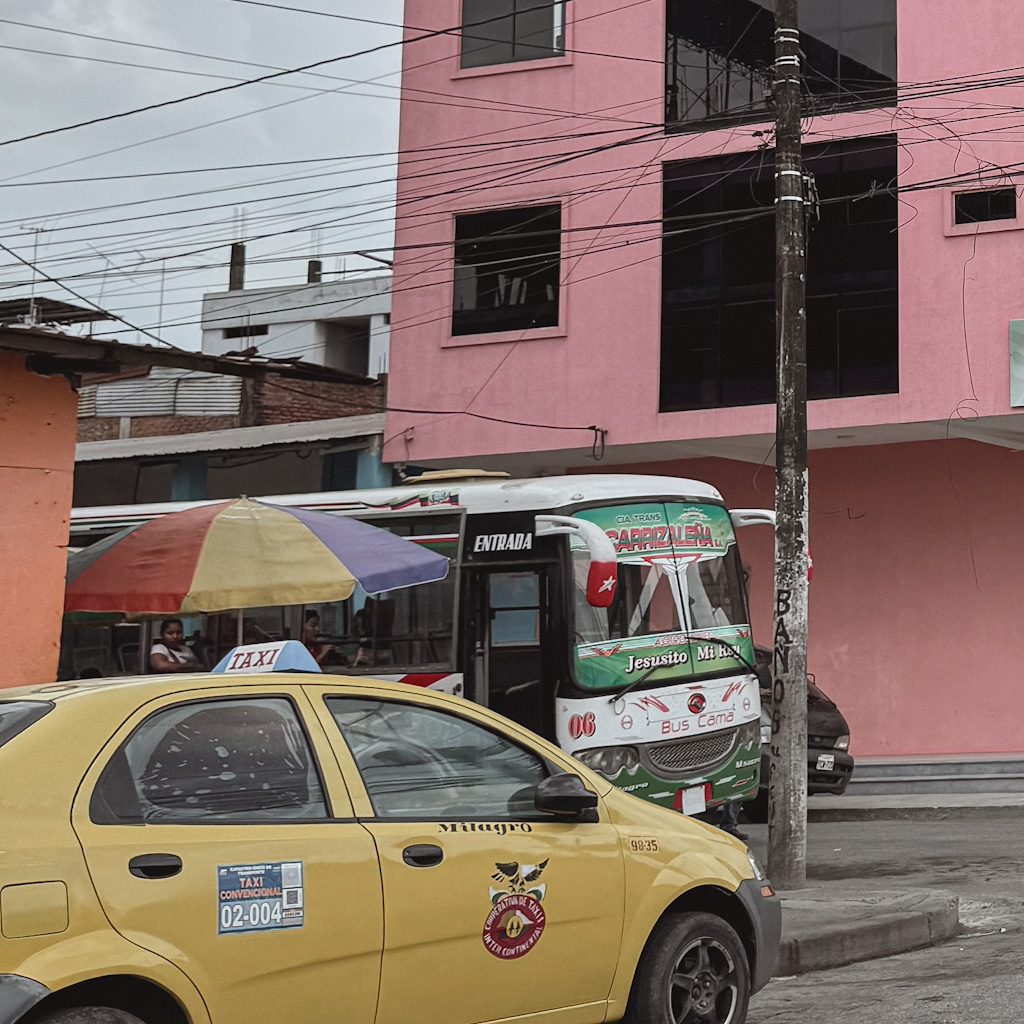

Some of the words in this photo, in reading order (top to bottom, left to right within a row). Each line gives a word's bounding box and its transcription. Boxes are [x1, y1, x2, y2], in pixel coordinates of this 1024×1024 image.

[633, 512, 661, 523] TRANS
[473, 532, 533, 552] ENTRADA
[229, 648, 280, 670] TAXI
[625, 650, 688, 673] Jesusito
[696, 644, 716, 661] Mi
[568, 712, 596, 740] 06
[661, 718, 690, 734] Bus
[697, 711, 735, 728] Cama
[438, 822, 533, 836] Milagro
[239, 876, 263, 888] TAXI
[220, 887, 282, 899] CONVENCIONAL
[519, 896, 527, 906] DE
[221, 901, 282, 928] 02-004
[483, 932, 501, 955] INTER
[502, 927, 542, 956] CONTINENTAL
